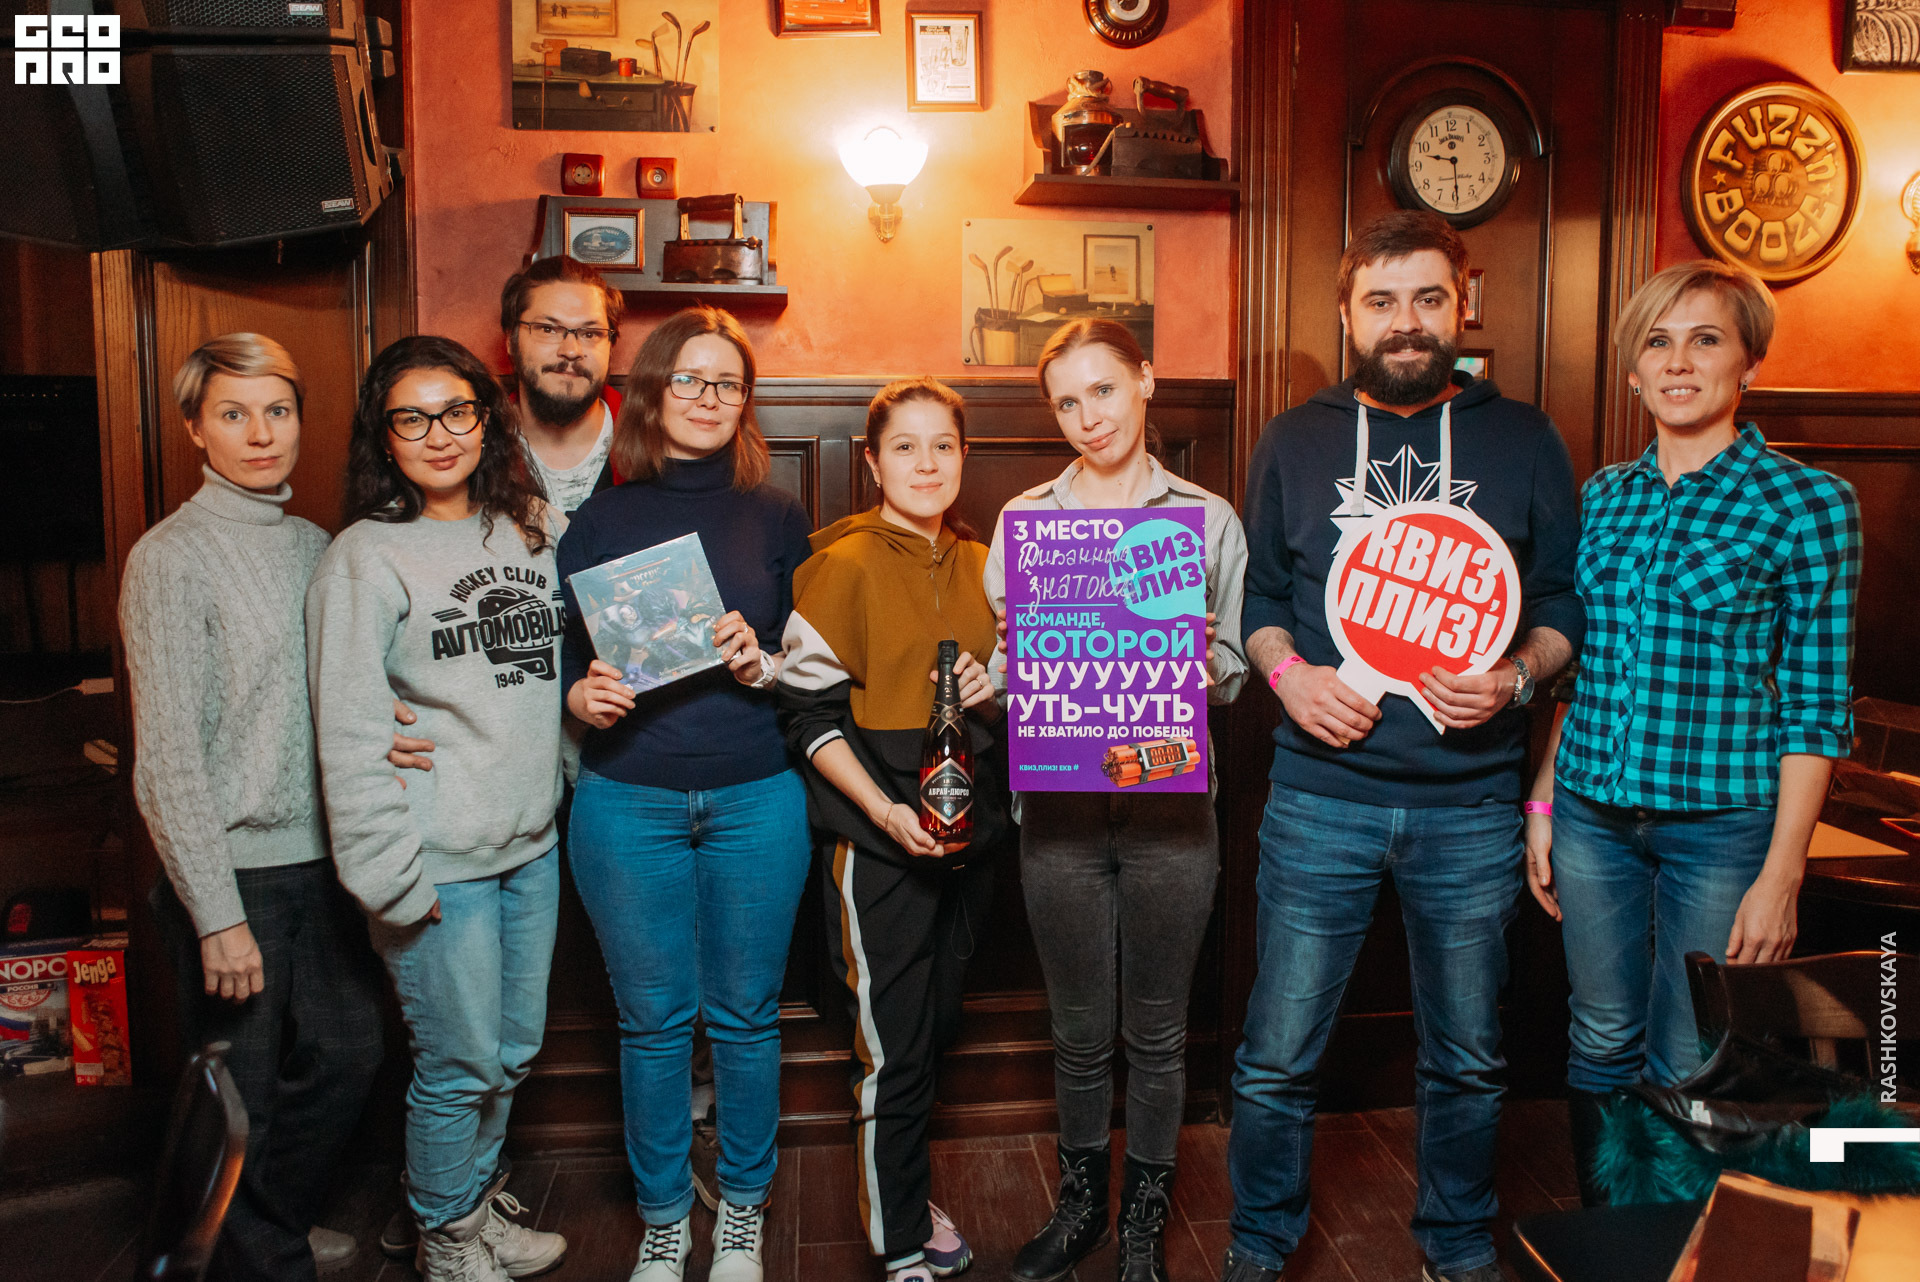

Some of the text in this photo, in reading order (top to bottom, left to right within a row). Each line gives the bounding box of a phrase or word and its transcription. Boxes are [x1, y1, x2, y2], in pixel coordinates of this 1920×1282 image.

[1430, 125, 1438, 138] 11
[1446, 119, 1457, 131] 12
[1466, 122, 1470, 134] 1
[1418, 141, 1430, 153] 10
[1478, 135, 1485, 147] 2
[1484, 152, 1491, 164] 3
[1415, 160, 1422, 172] 9
[1423, 178, 1430, 190] 8
[1479, 172, 1485, 183] 4
[1437, 188, 1443, 200] 7
[1468, 185, 1475, 197] 5
[1704, 188, 1839, 262] BOOZE
[1013, 519, 1124, 541] 3 МЕСТО
[1362, 520, 1501, 613] КВИЗ,
[449, 566, 547, 603] HOCKEY CLUB
[1016, 612, 1105, 628] КОМАНДЕ,
[1338, 567, 1500, 665] ПЛИЗ!
[1016, 622, 1195, 659] КОТОРОЙ
[494, 670, 525, 689] 1946
[1018, 725, 1193, 739] НЕ ХВАТИЛО ДО ПОБЕДЫ
[0, 957, 67, 981] NOPO
[73, 955, 117, 984] Jenga
[7, 983, 39, 993] РОССИЯ
